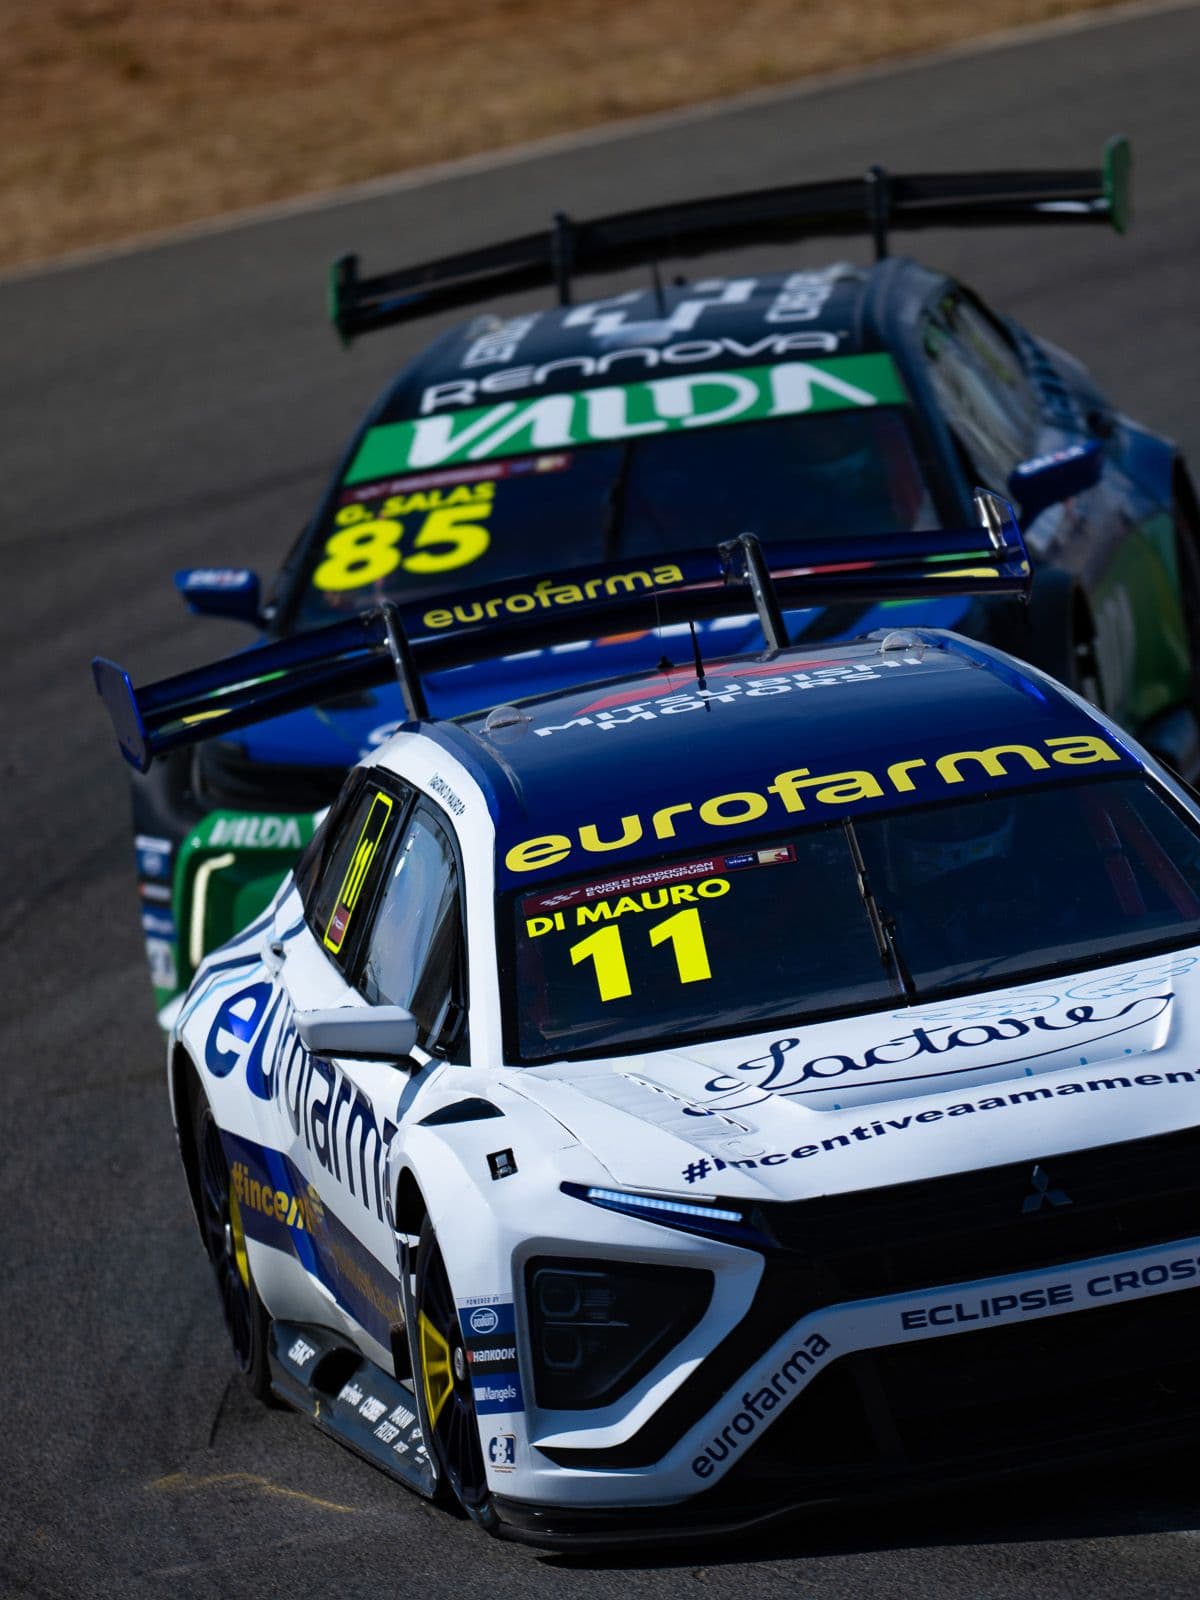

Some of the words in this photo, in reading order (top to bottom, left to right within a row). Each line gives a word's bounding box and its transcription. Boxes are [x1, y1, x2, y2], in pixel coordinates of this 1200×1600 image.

[406, 362, 878, 468] VALDA
[383, 481, 496, 517] SALAS
[312, 502, 492, 591] 85
[423, 564, 684, 629] eurofarma
[533, 657, 922, 737] MITSUBISHI
[595, 670, 882, 731] MOTORS
[208, 817, 302, 848] VALDA
[504, 735, 1121, 873] eurofarma
[595, 882, 631, 894] VOTE
[653, 865, 714, 881] FANPUSH
[632, 867, 688, 883] PADDOCK
[689, 861, 714, 871] FAN
[526, 912, 565, 938] DI
[576, 878, 731, 926] MAURO
[570, 908, 712, 1002] 11
[901, 1284, 1073, 1331] ECLIPSE
[692, 1333, 831, 1478] eurofarma
